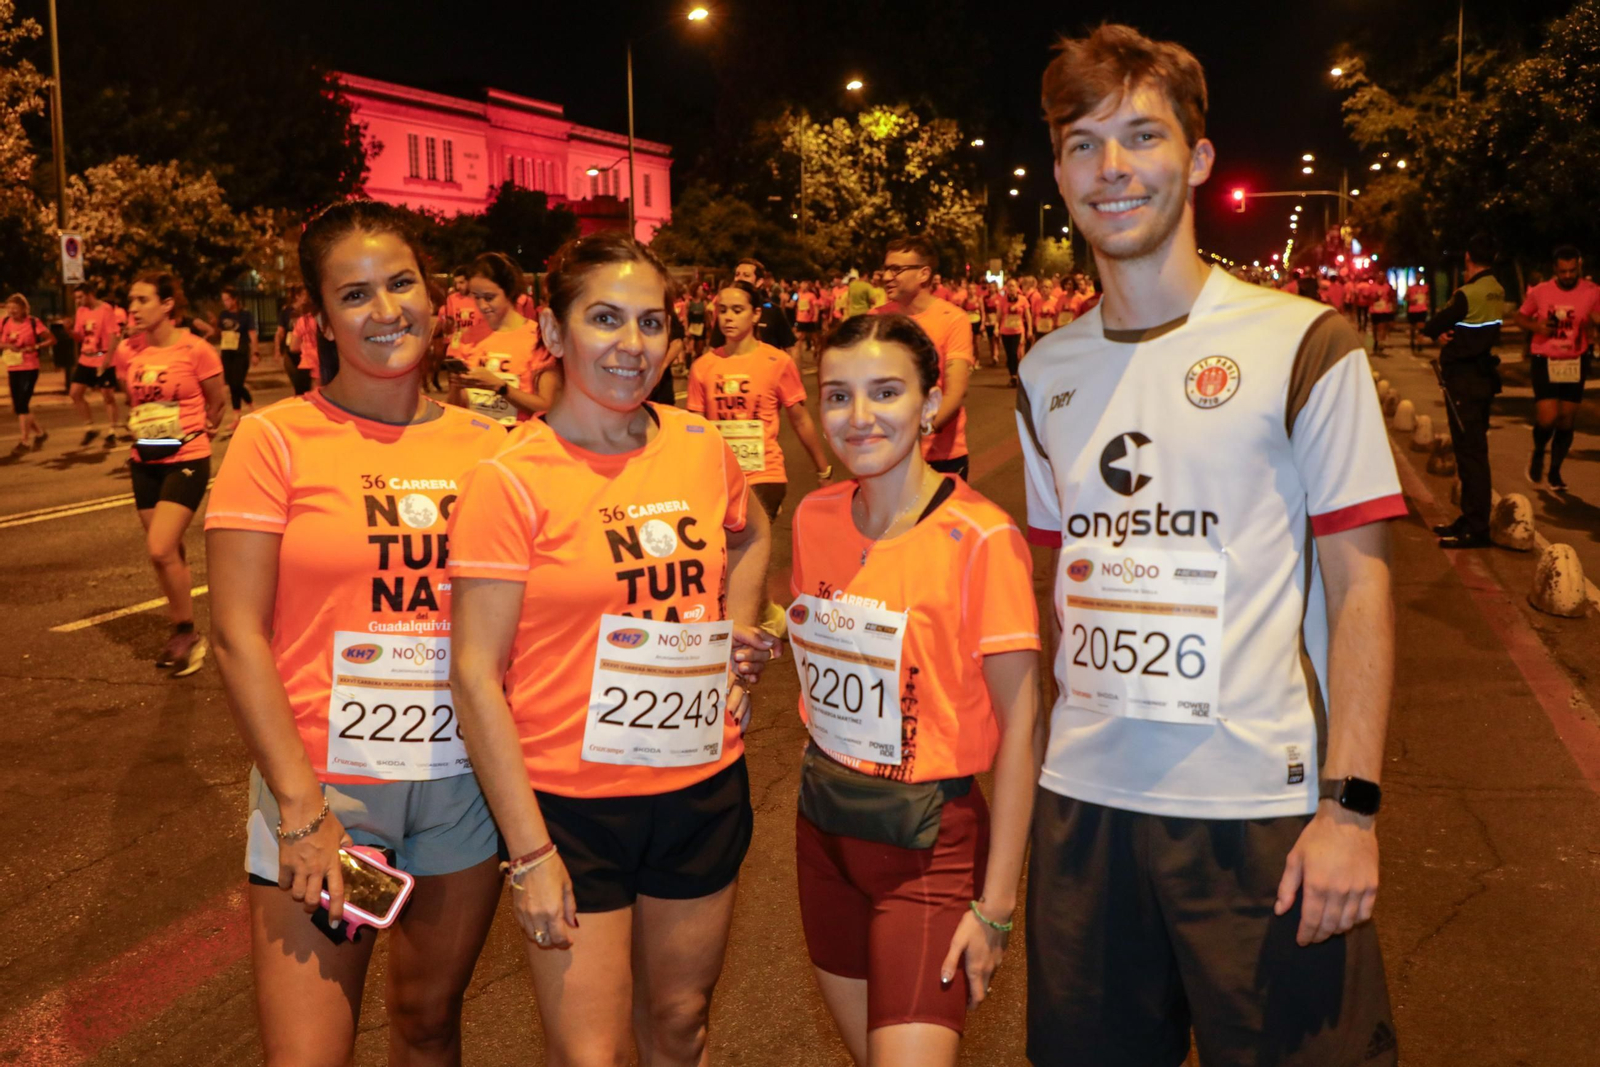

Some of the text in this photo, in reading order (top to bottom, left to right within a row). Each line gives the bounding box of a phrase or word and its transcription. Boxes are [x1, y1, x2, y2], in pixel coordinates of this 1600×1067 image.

[361, 474, 458, 490] 36 CARRERA
[599, 500, 690, 524] 36 CARRERA
[372, 576, 439, 612] NA
[616, 559, 706, 605] TUR
[815, 581, 887, 611] 36 CARRERA
[416, 612, 429, 620] del
[1072, 624, 1206, 679] 20526
[338, 701, 464, 743] 2222
[598, 686, 720, 729] 22243
